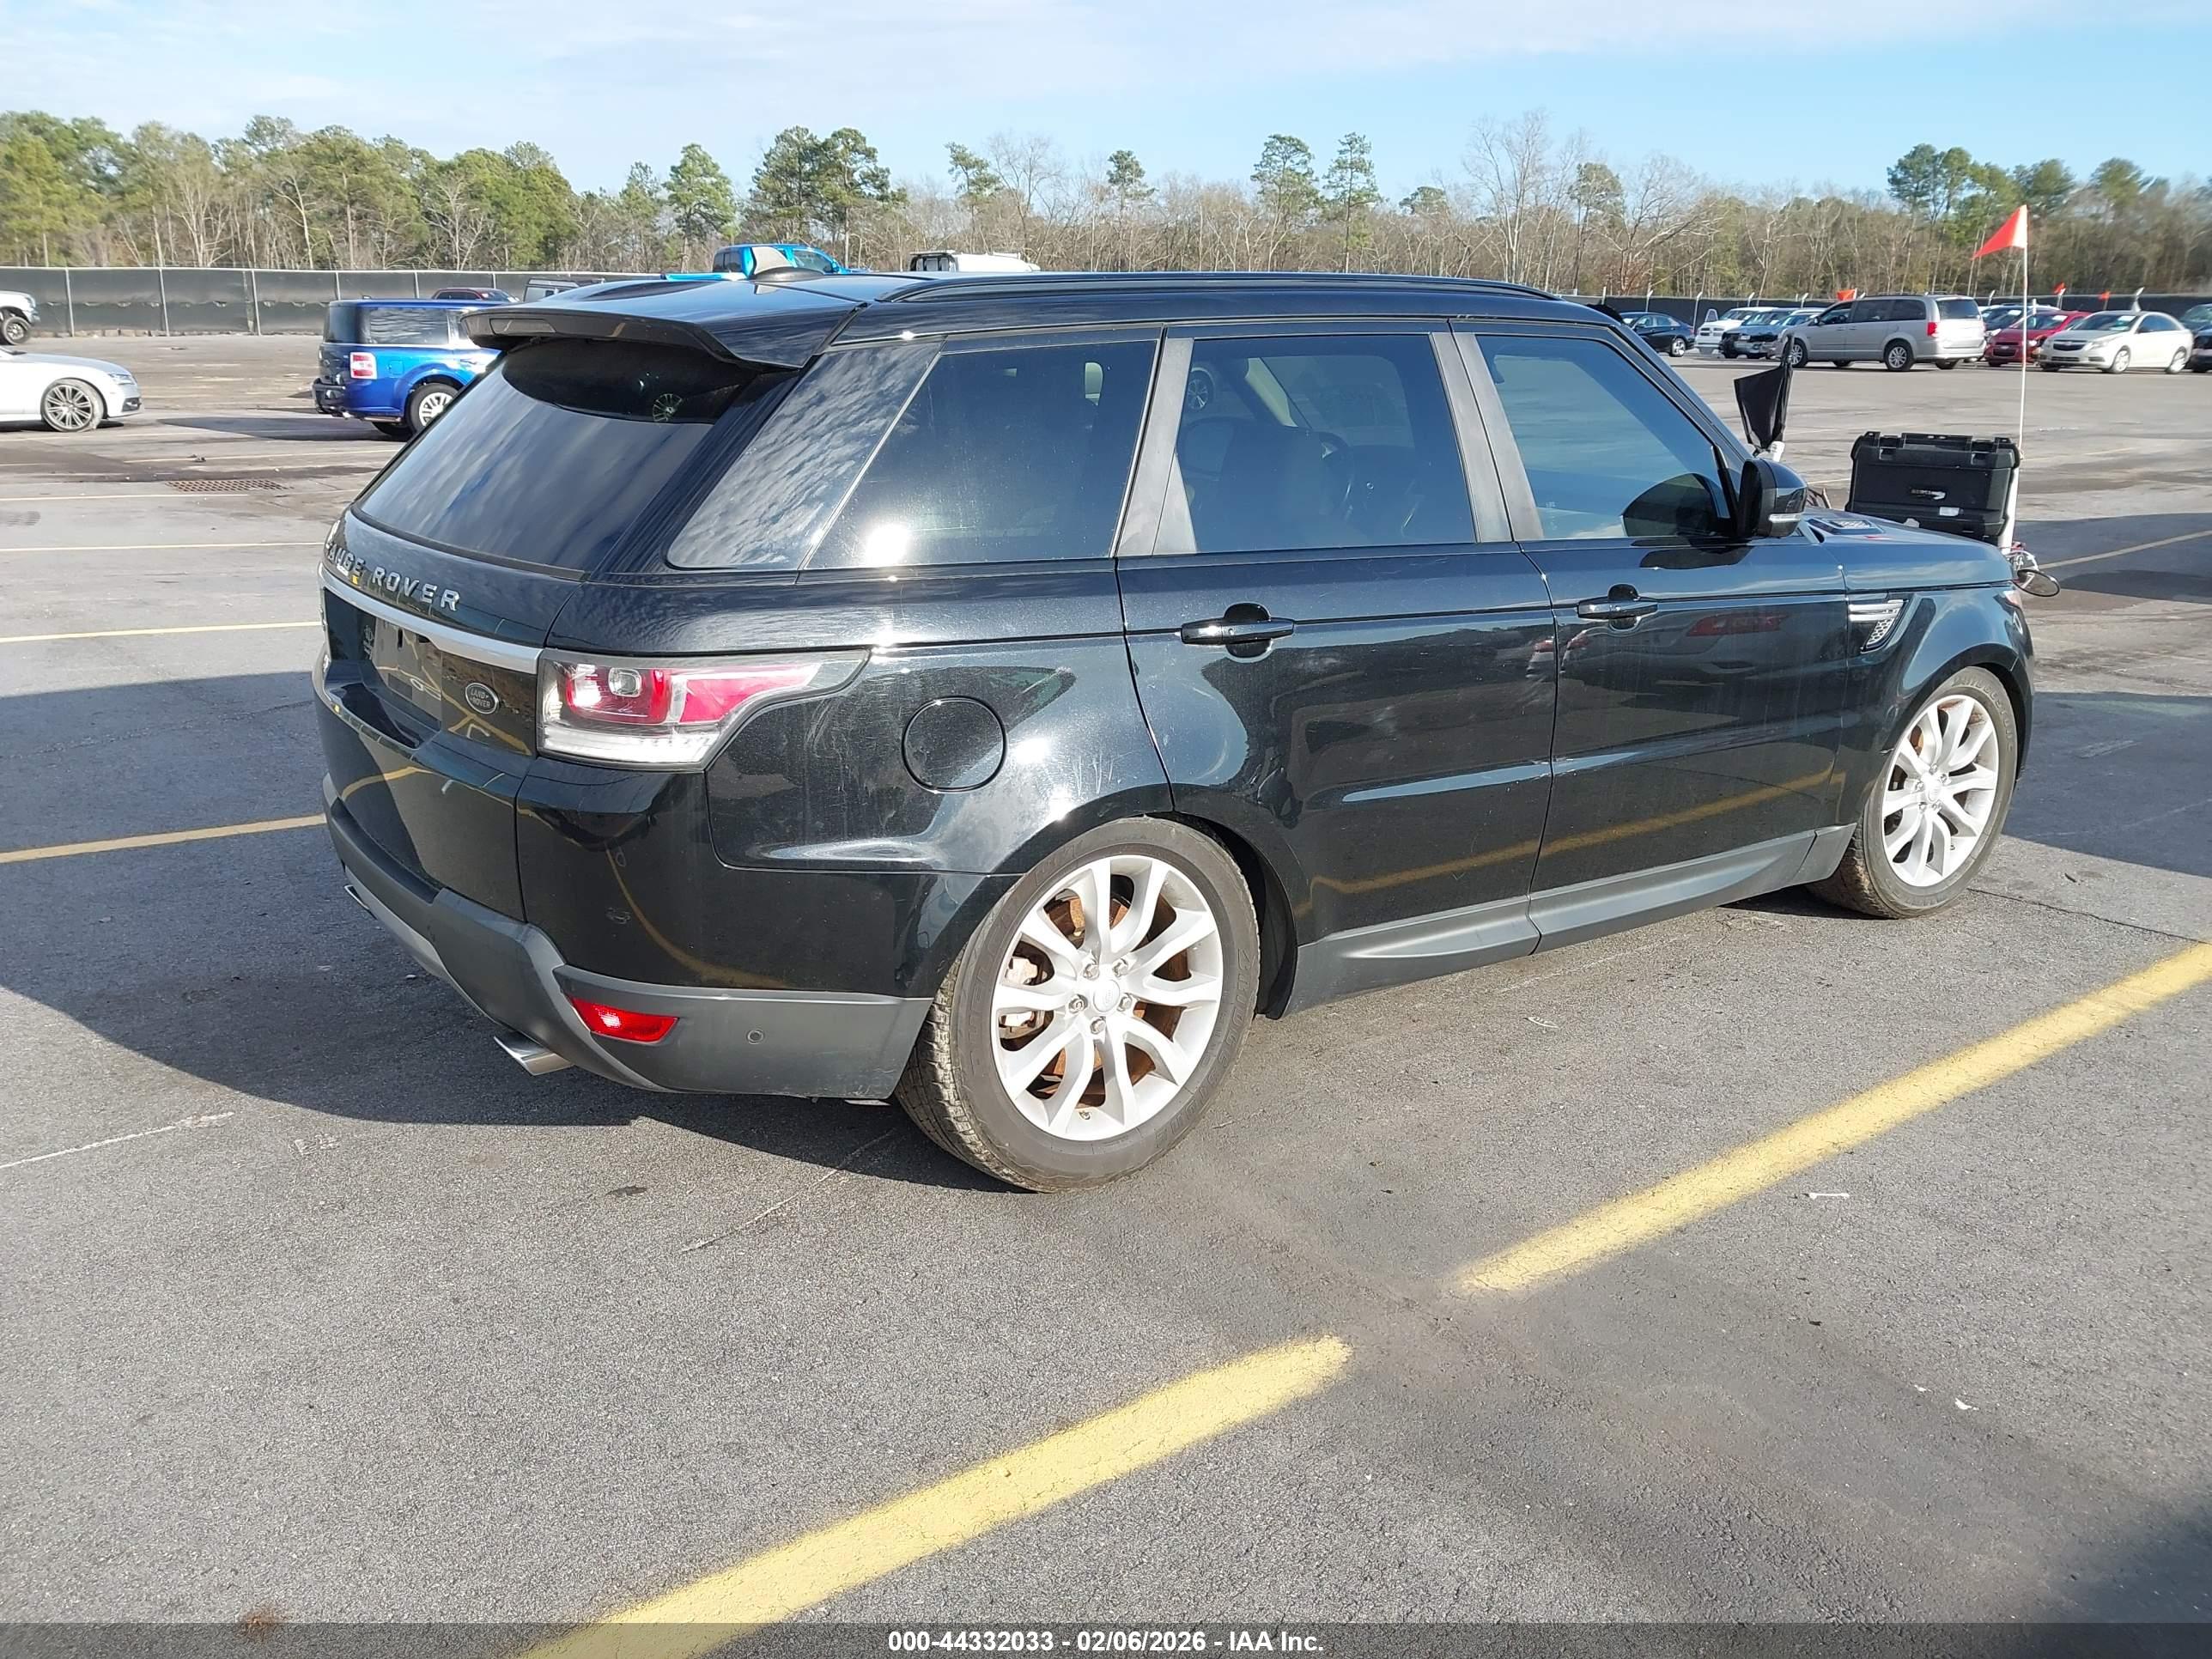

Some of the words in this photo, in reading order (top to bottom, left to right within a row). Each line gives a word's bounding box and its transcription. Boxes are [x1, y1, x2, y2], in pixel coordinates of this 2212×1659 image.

[372, 566, 460, 611] ROVER
[471, 688, 485, 699] LAND
[472, 697, 491, 708] ROVER
